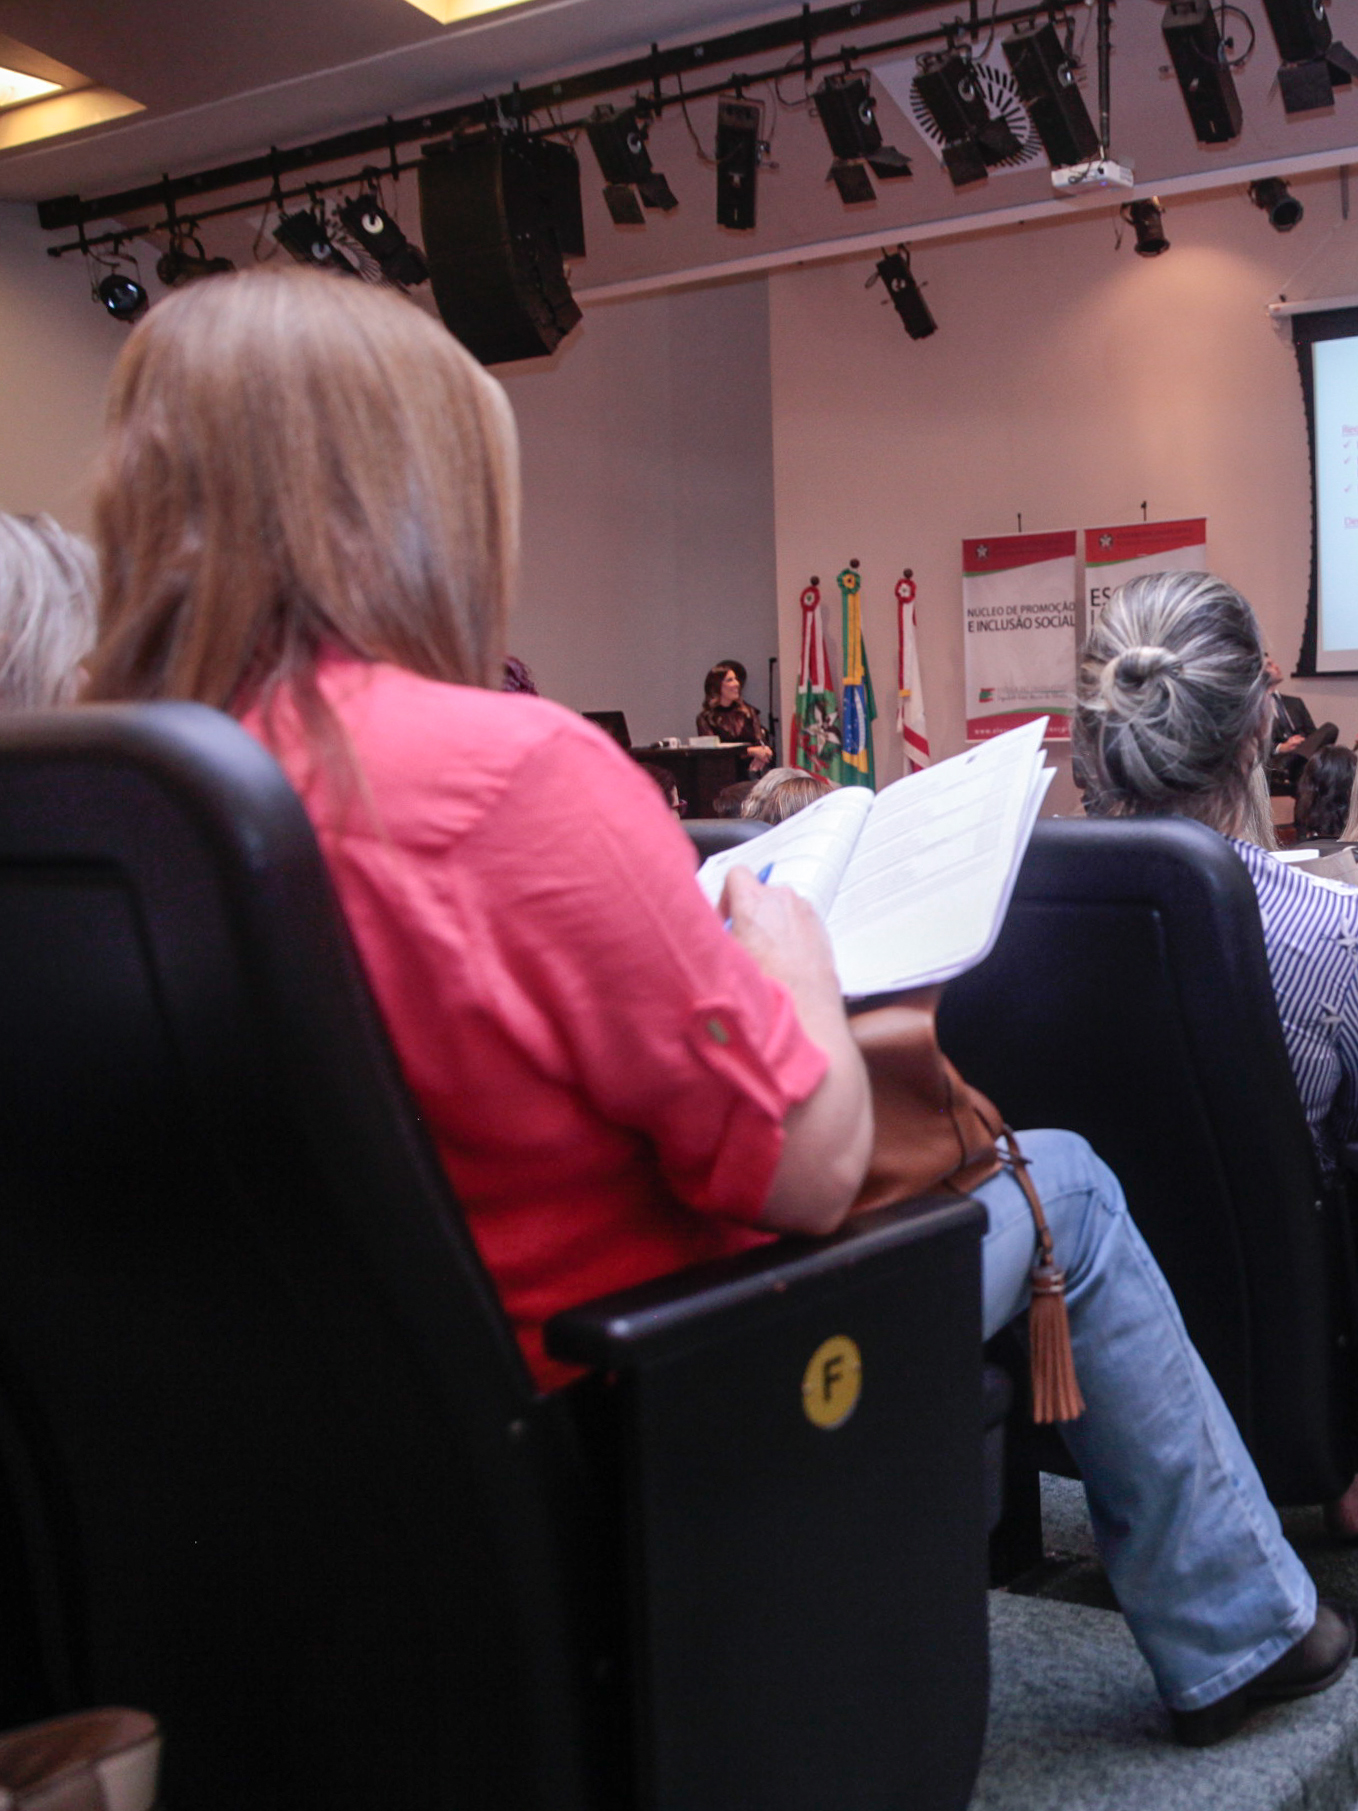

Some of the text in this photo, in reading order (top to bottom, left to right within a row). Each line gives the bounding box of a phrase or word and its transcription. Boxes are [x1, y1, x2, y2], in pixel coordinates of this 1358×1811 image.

[967, 601, 1076, 618] NÚCLEO DE PROMOÇÃO
[967, 620, 976, 633] E
[976, 615, 1033, 633] INCLUSÃO
[1034, 615, 1076, 630] SOCIAL
[822, 1355, 844, 1402] F
